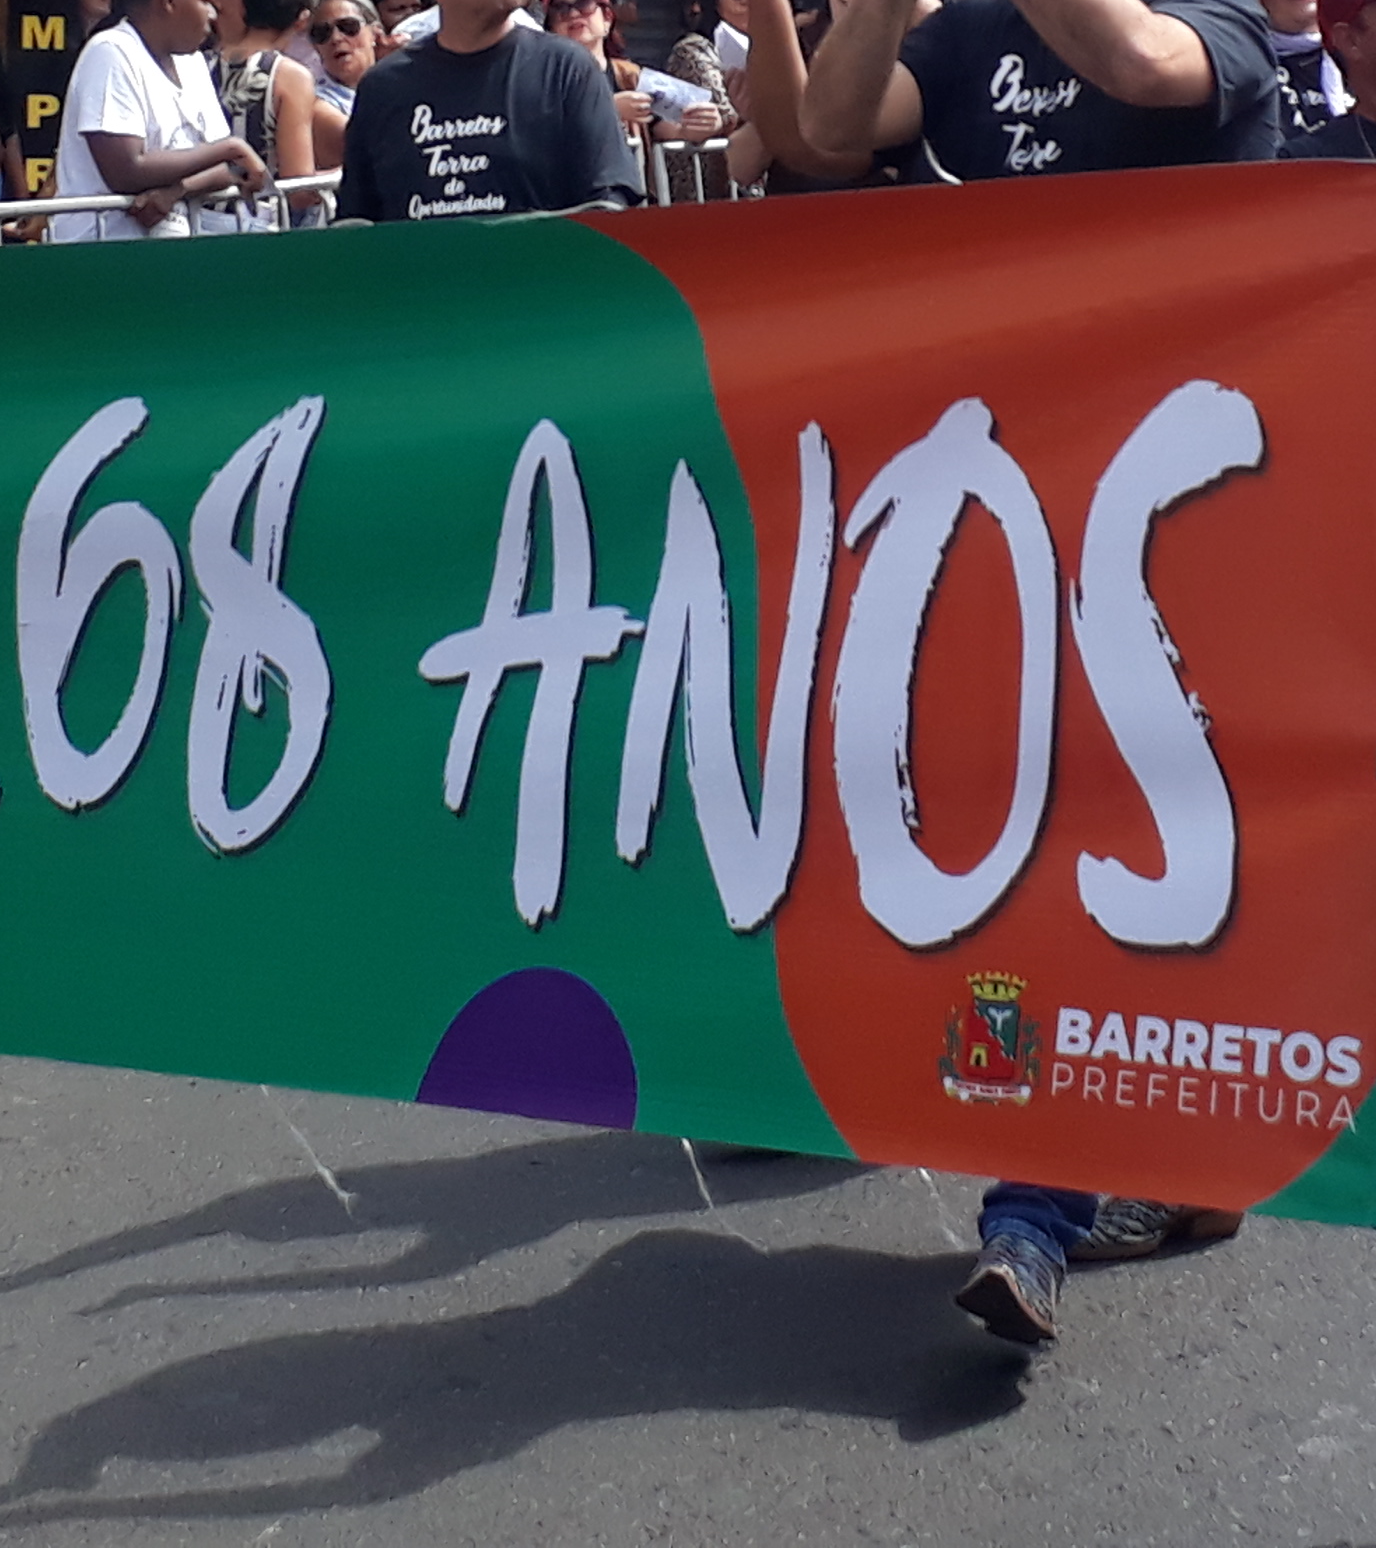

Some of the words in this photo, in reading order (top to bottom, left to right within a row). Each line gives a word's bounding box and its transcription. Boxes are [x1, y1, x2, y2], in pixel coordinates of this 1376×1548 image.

[411, 104, 507, 144] Barretos
[423, 144, 491, 177] Terra
[444, 177, 465, 196] de
[420, 379, 1264, 949] ANOS
[1055, 1006, 1363, 1087] BARRETOS
[1051, 1061, 1357, 1135] PREFEITURA
